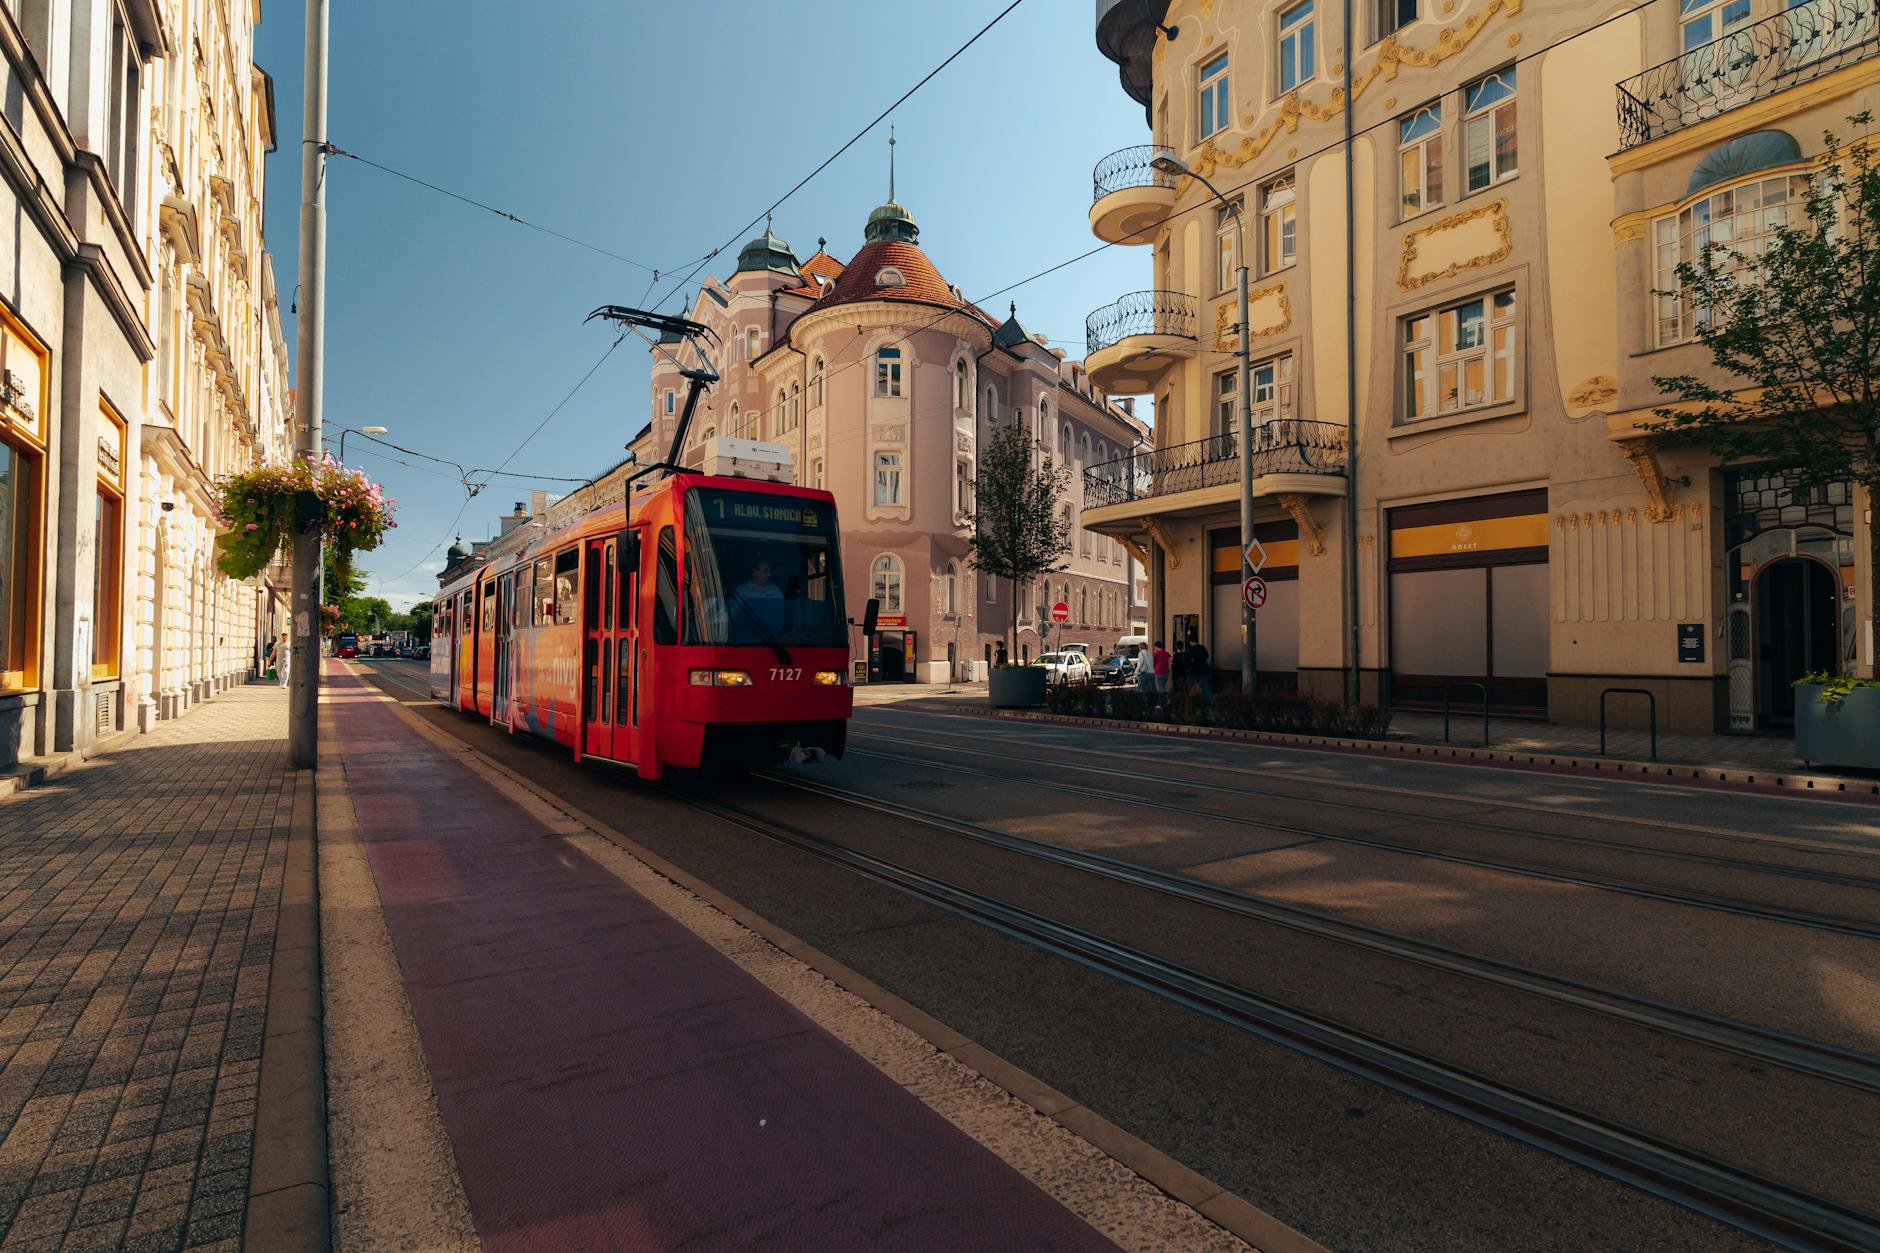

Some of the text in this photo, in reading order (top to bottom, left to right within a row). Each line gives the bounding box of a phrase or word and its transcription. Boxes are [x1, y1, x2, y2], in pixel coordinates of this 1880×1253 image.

[713, 498, 802, 522] 1 HLAV. STANICA
[769, 668, 802, 681] 7127
